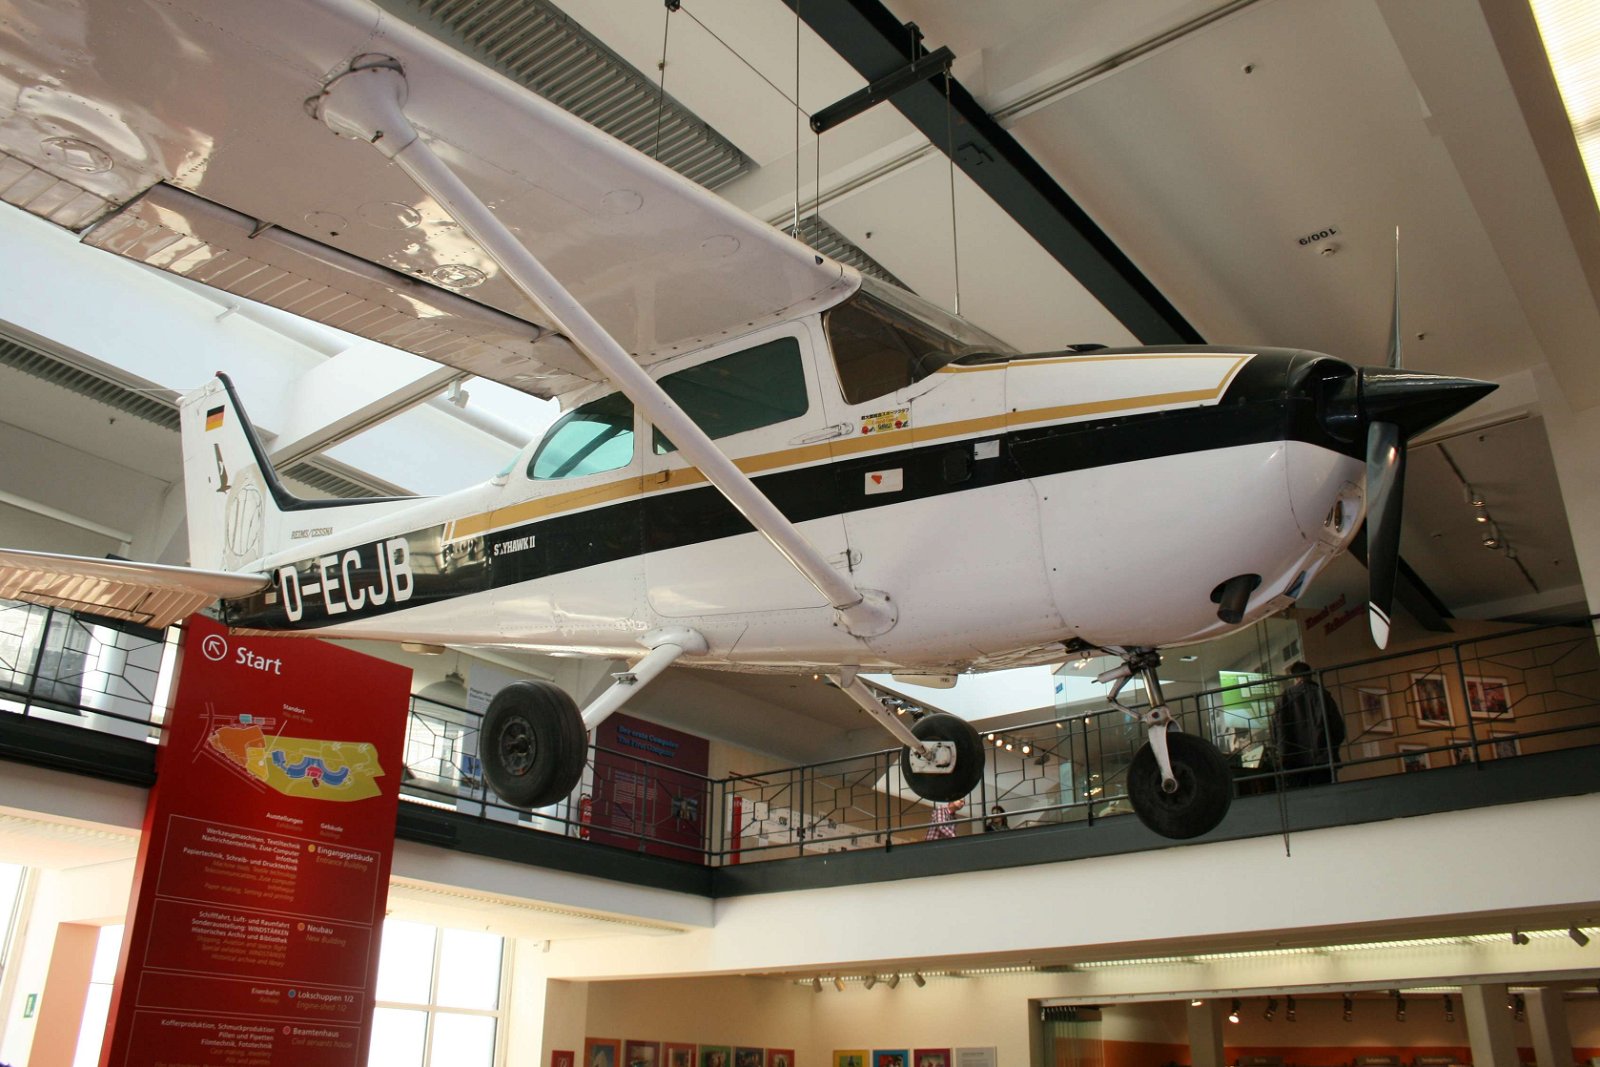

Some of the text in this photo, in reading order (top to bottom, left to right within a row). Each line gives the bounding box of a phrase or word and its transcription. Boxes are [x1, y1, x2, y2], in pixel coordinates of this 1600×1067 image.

[530, 535, 536, 549] II
[279, 537, 414, 623] D-ECJB
[236, 647, 282, 676] Start
[283, 703, 306, 715] Standort
[266, 812, 304, 825] Ausstellungen
[320, 822, 344, 833] Gebäude
[202, 834, 300, 858] Nachrichtentechnik, Zuse-Computer
[267, 838, 301, 850] Textiltechnik
[183, 847, 298, 872] Papiertechnik, Schreib- und Drucktechnik
[316, 846, 374, 863] Eingangsgebäude
[233, 914, 247, 924] Luft-
[248, 917, 260, 925] und
[260, 918, 290, 928] Raumfahrt
[192, 926, 288, 944] Historisches Archiv und Bibliothek
[248, 924, 289, 936] WINDSTÄRKEN
[307, 924, 334, 936] Neubau
[251, 987, 280, 997] Eisenbahn
[298, 990, 354, 1004] Lokschuppen 1/2
[161, 1018, 276, 1034] Kofferproduktion, Schmuckproduktion
[292, 1027, 340, 1038] Beamtenhaus
[218, 1031, 274, 1043] Pillen und Pipetten
[201, 1038, 273, 1050] Filmtechnik, Fototechnik
